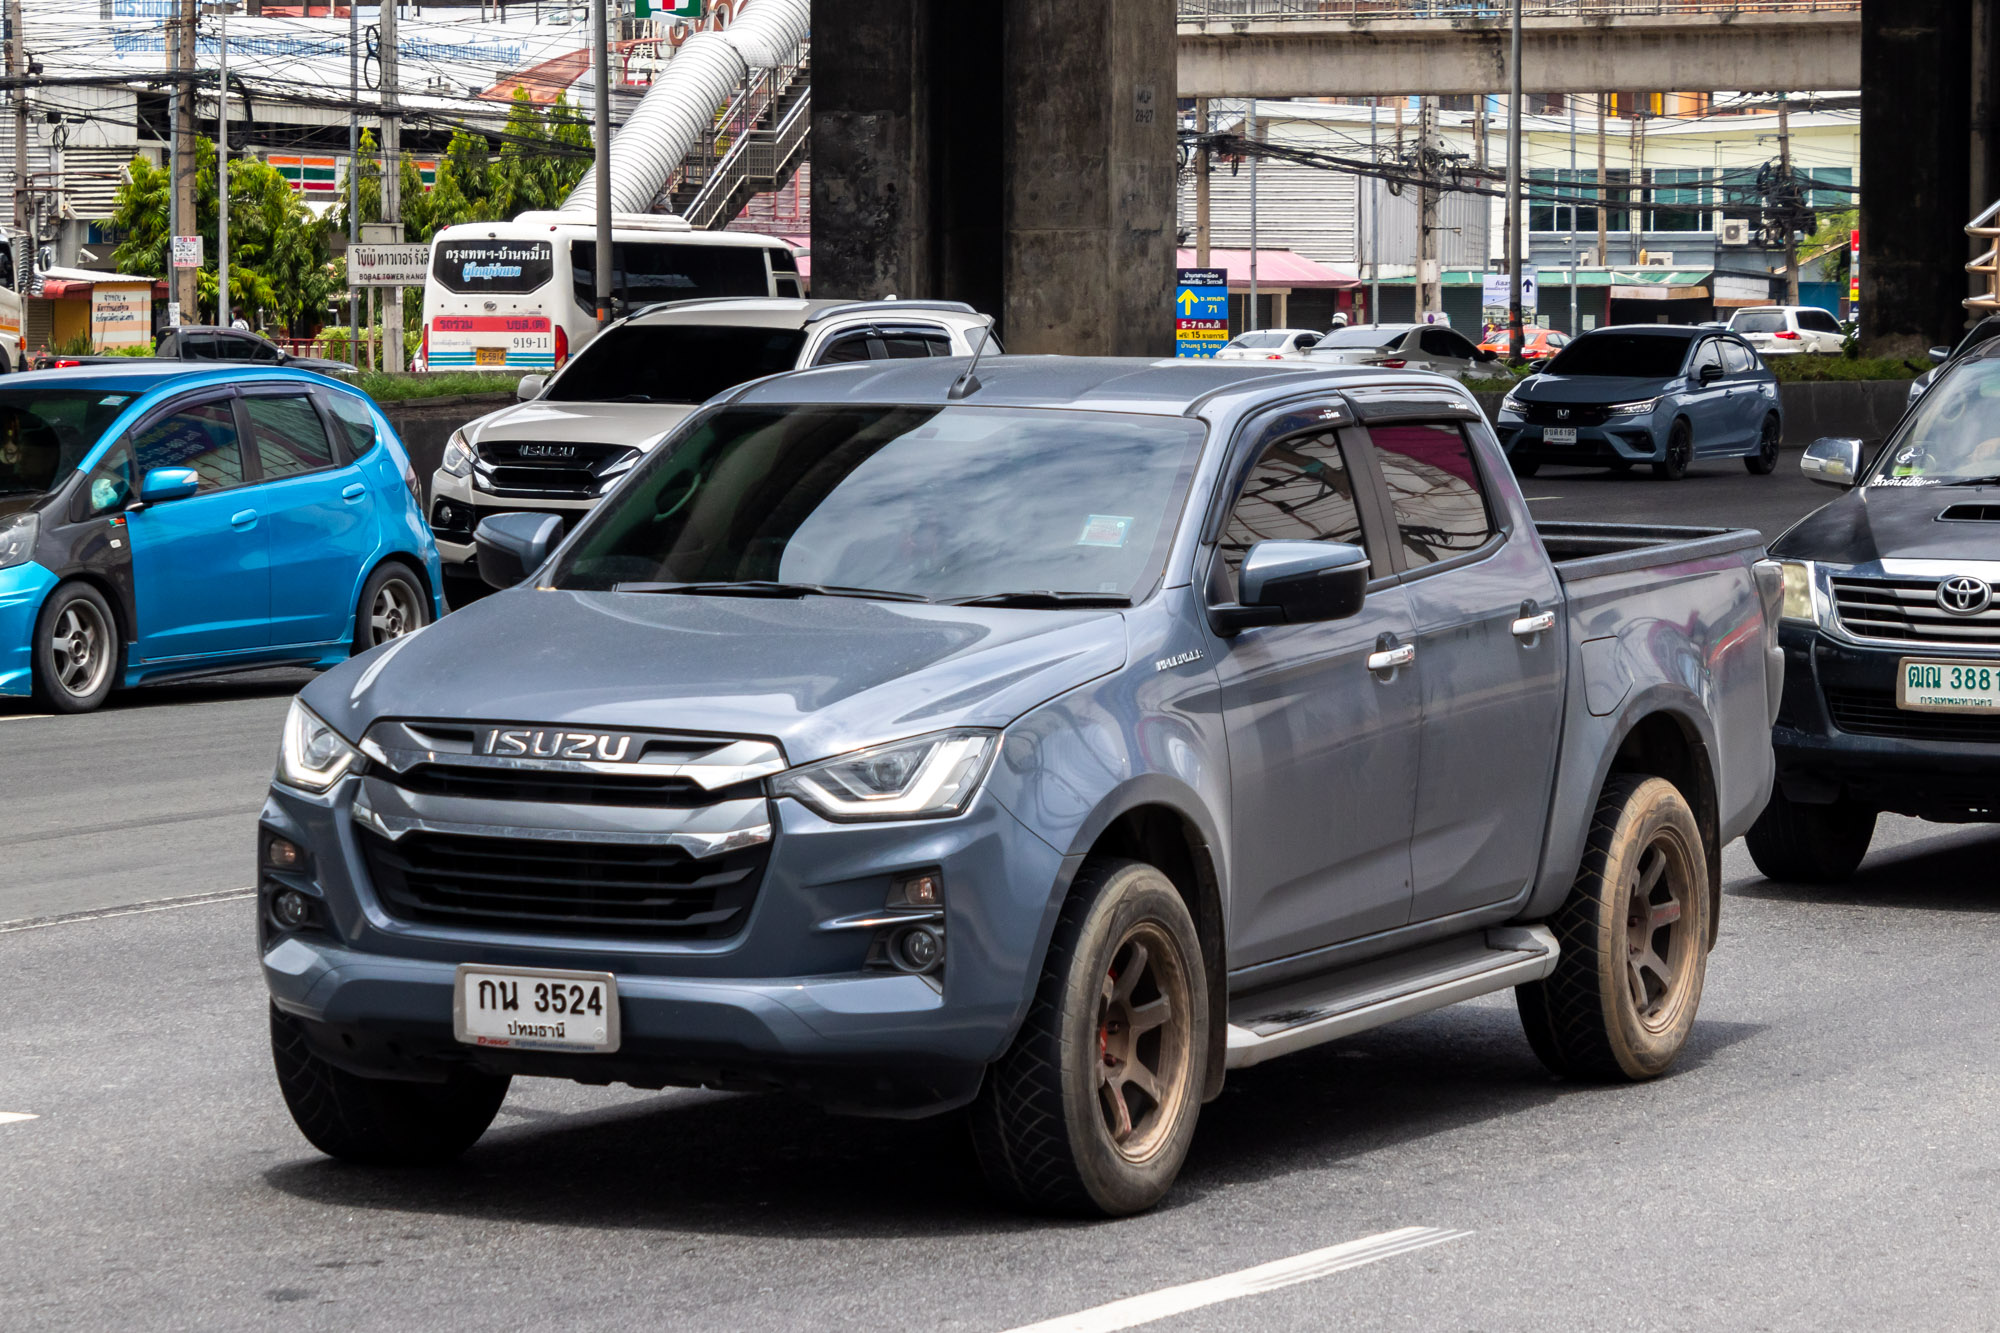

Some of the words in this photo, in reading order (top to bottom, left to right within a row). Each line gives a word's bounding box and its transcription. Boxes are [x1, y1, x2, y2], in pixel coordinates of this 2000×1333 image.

[415, 247, 430, 266] รังสิ
[1207, 305, 1218, 313] 71
[1181, 321, 1197, 329] 5-7
[1191, 331, 1200, 339] 15
[513, 337, 547, 348] 919-11
[520, 445, 575, 457] ISUZU
[482, 729, 631, 761] ISUZU
[478, 980, 519, 1011] กน
[534, 982, 603, 1017] 3524
